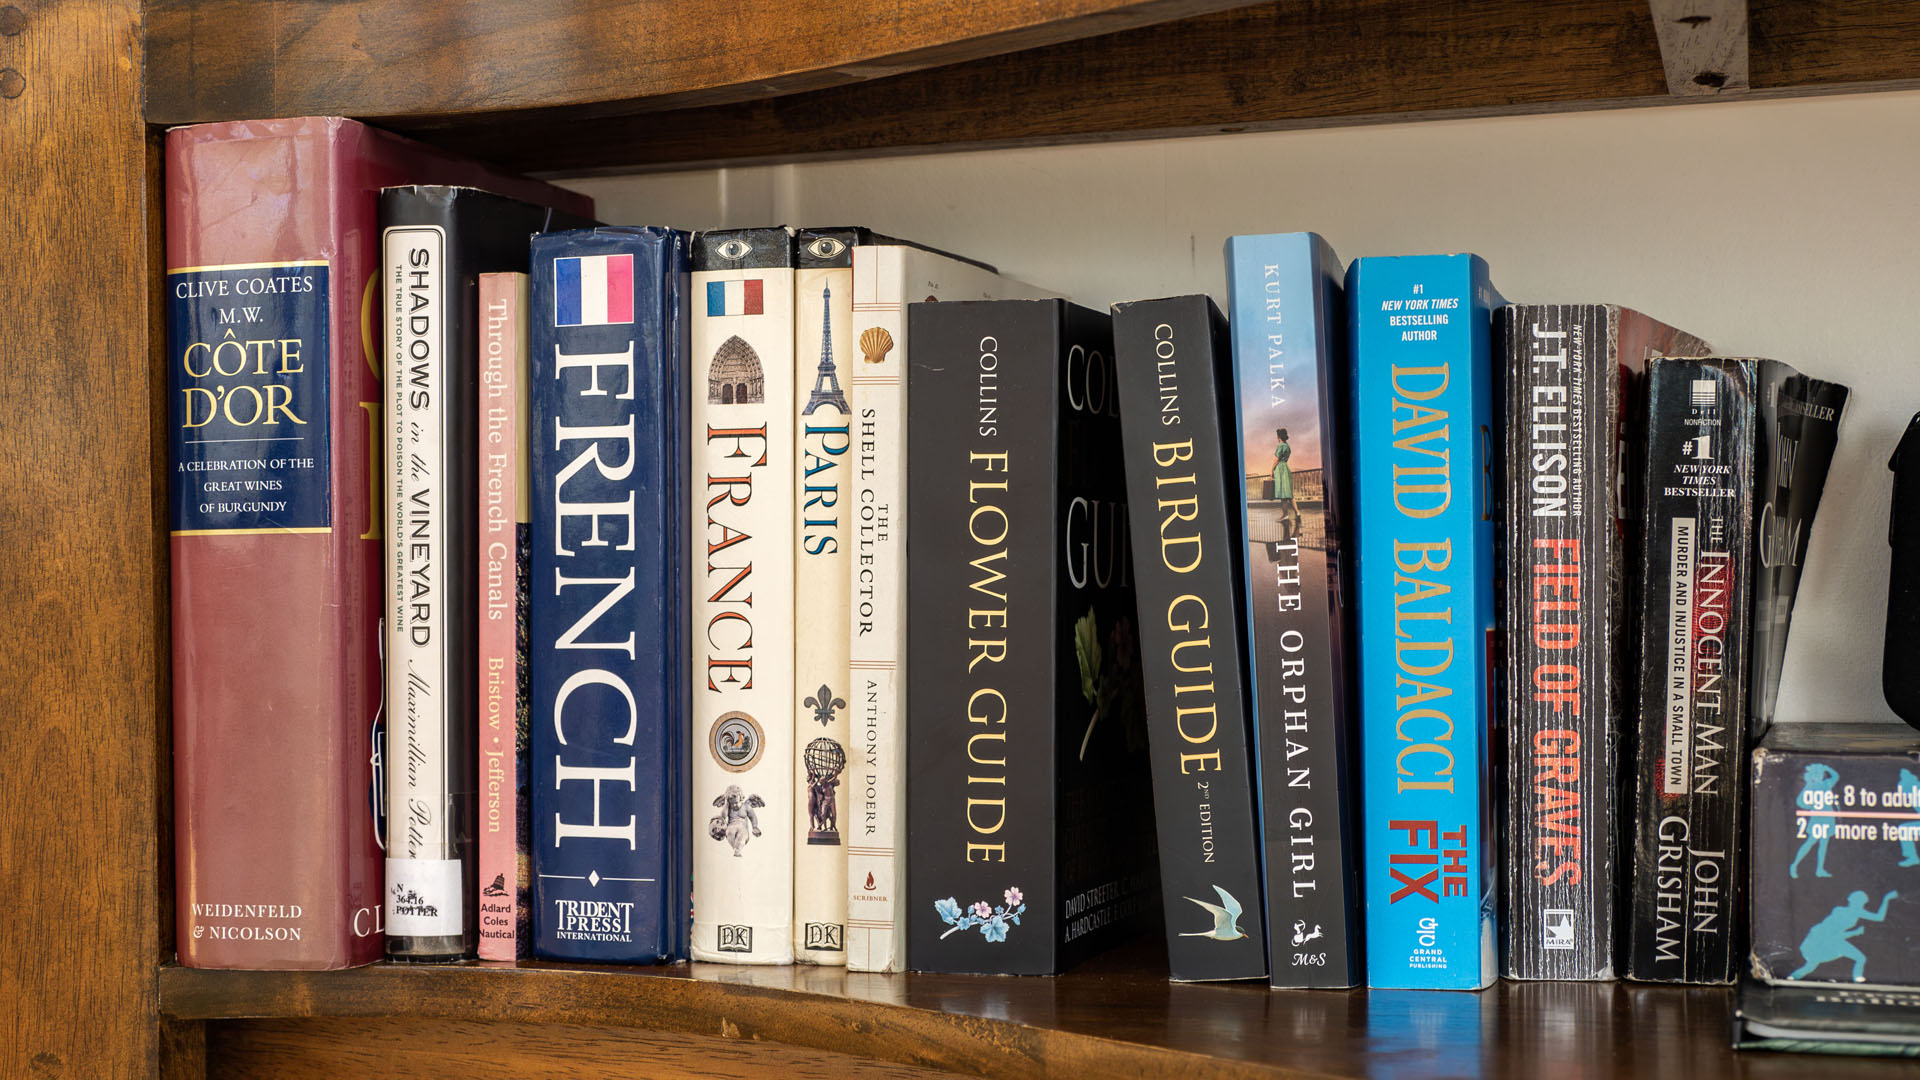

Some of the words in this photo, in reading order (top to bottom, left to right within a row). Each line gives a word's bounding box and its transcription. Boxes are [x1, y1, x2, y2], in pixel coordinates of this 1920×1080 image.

[176, 280, 229, 298] CLIVE
[236, 275, 313, 295] COATES
[1264, 263, 1282, 324] KURT
[1381, 300, 1403, 311] NEW
[1405, 299, 1429, 310] YORK
[1431, 298, 1459, 309] TIMES
[1413, 284, 1423, 294] #1
[219, 306, 264, 324] M.W.
[408, 248, 430, 411] SHADOWS
[1390, 314, 1448, 326] BESTSELLING
[1401, 330, 1437, 341] AUTHOR
[1573, 324, 1582, 346] NEW
[183, 328, 304, 378] CÔTE
[395, 352, 402, 367] OF
[483, 298, 508, 398] Through
[1532, 323, 1567, 374] J.T.
[1573, 349, 1582, 374] YORK
[979, 336, 998, 437] COLLINS
[1154, 323, 1181, 426] COLLINS
[1268, 333, 1286, 408] PALKA
[1573, 377, 1582, 406] TIMES
[182, 384, 308, 428] D'OR
[395, 391, 403, 417] PLOT
[396, 418, 403, 434] TO
[488, 406, 508, 444] the
[410, 421, 424, 444] in
[861, 408, 875, 481] SHELL
[1392, 361, 1451, 519] DAVID
[1532, 385, 1567, 517] ELLISON
[1572, 408, 1582, 475] BESTSELLING
[1682, 435, 1715, 460] #1
[178, 462, 184, 472] A
[186, 459, 267, 472] CELEBRATION
[270, 459, 287, 469] OF
[288, 458, 314, 469] THE
[204, 481, 242, 492] GREAT
[244, 480, 282, 491] WINES
[410, 453, 430, 482] the
[1673, 464, 1700, 474] NEW
[1701, 465, 1731, 475] YORK
[1682, 475, 1716, 486] TIMES
[200, 503, 215, 513] OF
[218, 501, 287, 513] BURGUNDY
[488, 453, 508, 533] French
[803, 421, 850, 555] PARIS
[1152, 437, 1202, 573] BIRD
[1572, 477, 1582, 516] AUTHOR
[1664, 487, 1735, 498] BESTSELLER
[877, 503, 888, 542] THE
[1711, 515, 1723, 543] THE
[410, 488, 431, 648] VINEYARD
[707, 421, 768, 693] FRANCE
[859, 489, 875, 637] COLLECTOR
[968, 449, 1008, 674] FLOWER
[1676, 526, 1688, 577] MURDER
[396, 550, 404, 602] GREATEST
[488, 541, 508, 621] Canals
[554, 340, 637, 851] FRENCH
[1275, 537, 1302, 612] THE
[1533, 538, 1581, 650] FIELD
[1675, 581, 1687, 606] AND
[396, 605, 404, 633] WINE
[1697, 549, 1730, 715] INNOCENT
[1673, 610, 1687, 673] INJUSTICE
[1167, 594, 1222, 775] GUIDE
[1394, 537, 1455, 794] BALDACCI
[1673, 676, 1684, 689] IN
[488, 657, 504, 730] Bristow
[1280, 630, 1310, 790] ORPHAN
[1533, 664, 1581, 716] OF
[1673, 693, 1684, 701] A
[866, 679, 877, 766] ANTHONY
[1672, 705, 1683, 746] SMALL
[967, 688, 1007, 863] GUIDE
[1671, 749, 1682, 785] TOWN
[1694, 722, 1725, 797] MAN
[485, 749, 504, 833] Jefferson
[865, 774, 877, 836] DOERR
[1534, 729, 1582, 886] GRAVES
[1803, 790, 1839, 810] age:
[1843, 784, 1856, 807] 8
[1860, 787, 1877, 807] to
[1199, 803, 1215, 863] EDITION
[1796, 817, 1807, 838] 2
[1812, 823, 1830, 839] or
[1834, 824, 1877, 841] more
[1289, 807, 1316, 898] GIRL
[1389, 820, 1439, 904] FIX
[1442, 825, 1468, 897] THE
[192, 903, 302, 919] WEIDENFELD
[481, 903, 511, 913] Adlard
[1655, 815, 1690, 963] GRISHAM
[1687, 846, 1725, 934] JOHN
[193, 925, 205, 939] &
[209, 926, 302, 941] NICOLSON
[479, 929, 515, 939] Nautical
[483, 916, 508, 926] Coles
[555, 899, 634, 934] TRIDENT
[556, 931, 632, 943] INTERNATIONAL
[566, 916, 622, 933] PRESS
[721, 926, 749, 947] DK
[809, 924, 839, 946] DK
[1291, 952, 1326, 967] M&S
